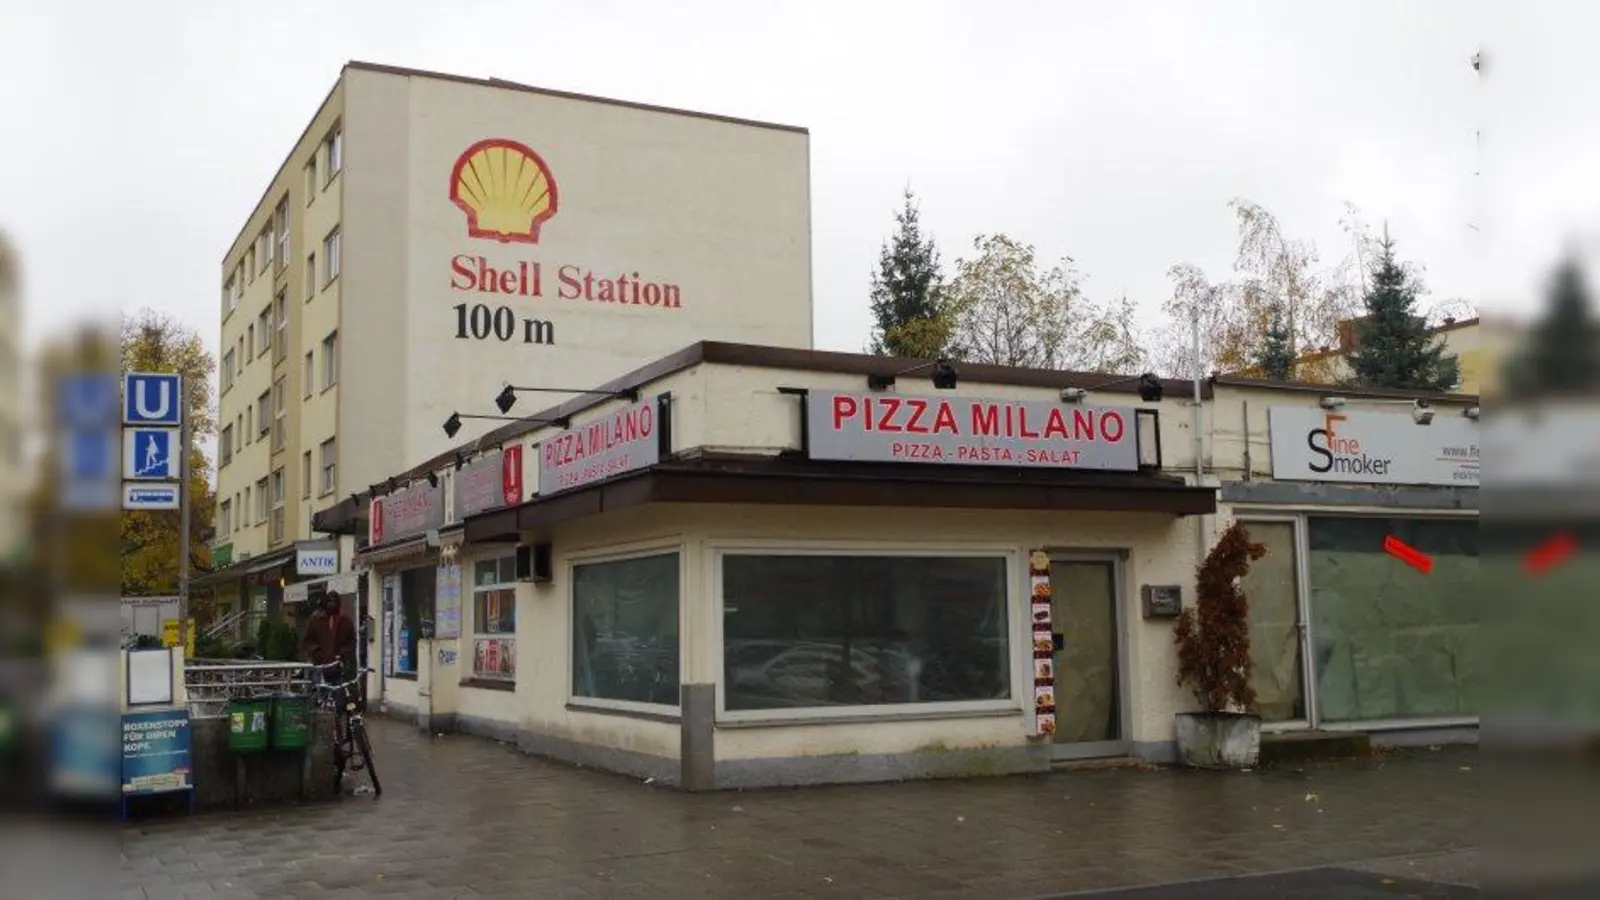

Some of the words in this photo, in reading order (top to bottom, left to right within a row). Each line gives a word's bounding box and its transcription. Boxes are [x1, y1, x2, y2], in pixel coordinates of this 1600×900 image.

[451, 254, 542, 296] Shell
[558, 264, 682, 308] Station
[453, 303, 515, 341] 100
[523, 319, 555, 344] m
[136, 379, 170, 419] U
[832, 395, 959, 435] PIZZA
[971, 403, 1125, 443] MILANO
[544, 430, 585, 470] PIZZA
[588, 402, 653, 458] MILANO
[892, 442, 943, 459] PIZZA
[958, 446, 1013, 462] PASTA
[1027, 449, 1081, 465] SALAT
[1308, 428, 1392, 475] Smoker
[1326, 414, 1360, 455] Fine
[301, 555, 335, 568] ANTIK
